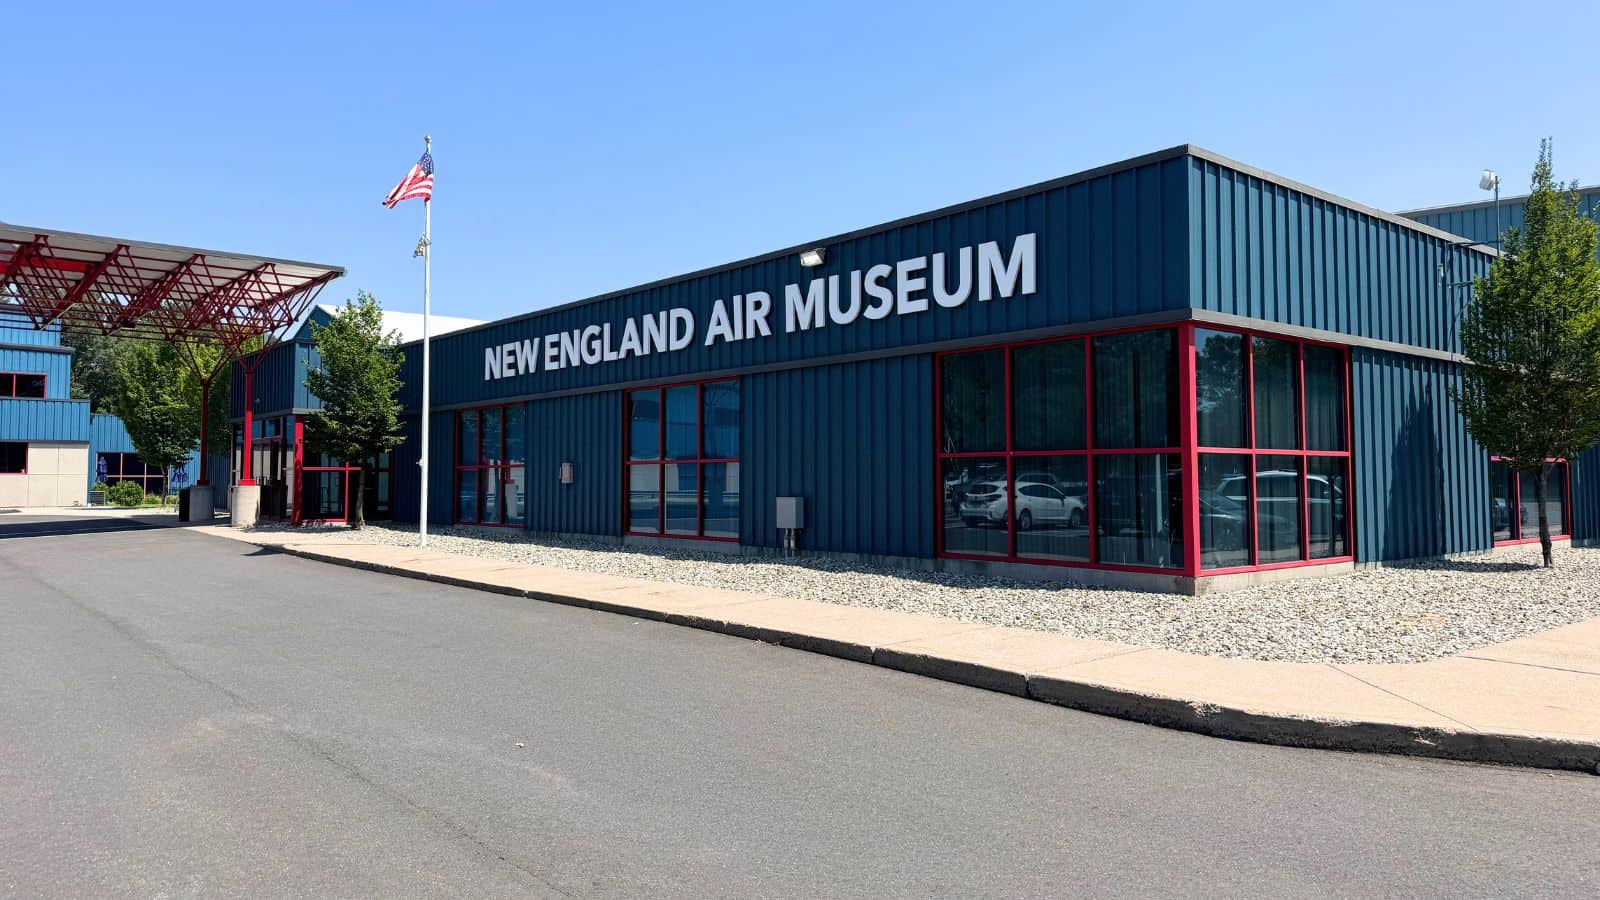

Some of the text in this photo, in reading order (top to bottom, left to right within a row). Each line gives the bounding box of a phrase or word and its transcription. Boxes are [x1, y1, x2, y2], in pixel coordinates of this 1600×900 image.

[484, 232, 1037, 381] NEW ENGLAND AIR MUSEUM
